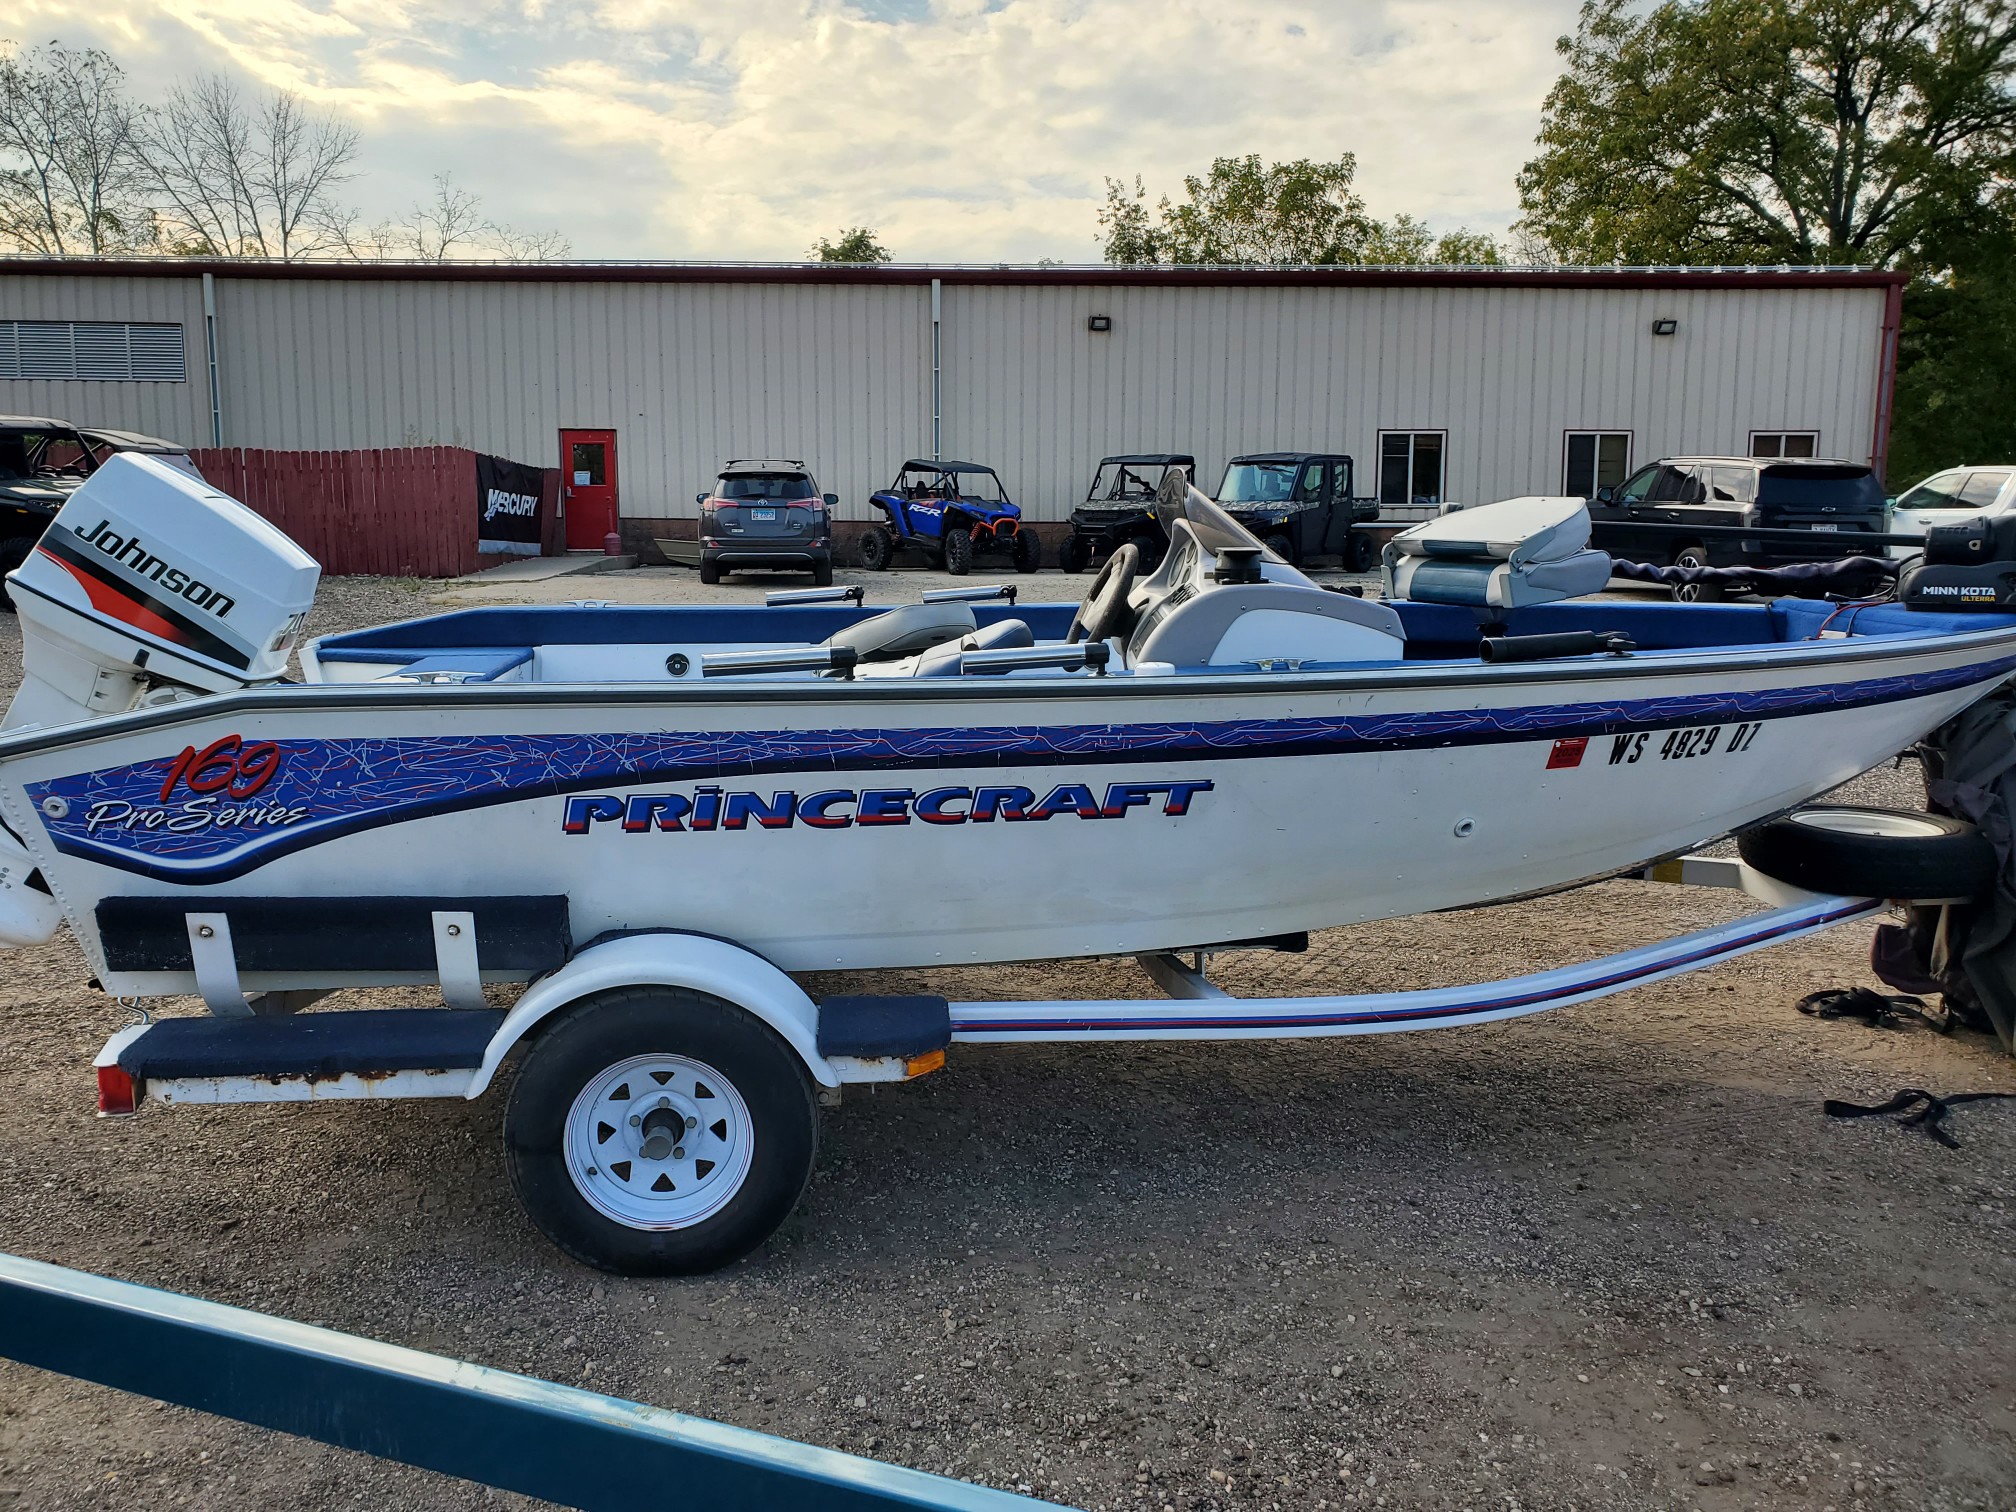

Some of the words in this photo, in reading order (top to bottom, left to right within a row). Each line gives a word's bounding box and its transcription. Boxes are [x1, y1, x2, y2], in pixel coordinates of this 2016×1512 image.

[486, 488, 539, 517] MERCURY
[908, 503, 942, 517] RZR
[73, 519, 237, 618] Johnson
[1922, 586, 1959, 596] MINN
[1960, 586, 1997, 596] KOTA
[1608, 732, 1650, 766] WS
[1660, 725, 1721, 761] 4829
[1725, 721, 1763, 754] DZ
[158, 733, 282, 804] 169
[561, 779, 1215, 836] PRINCECRAFT
